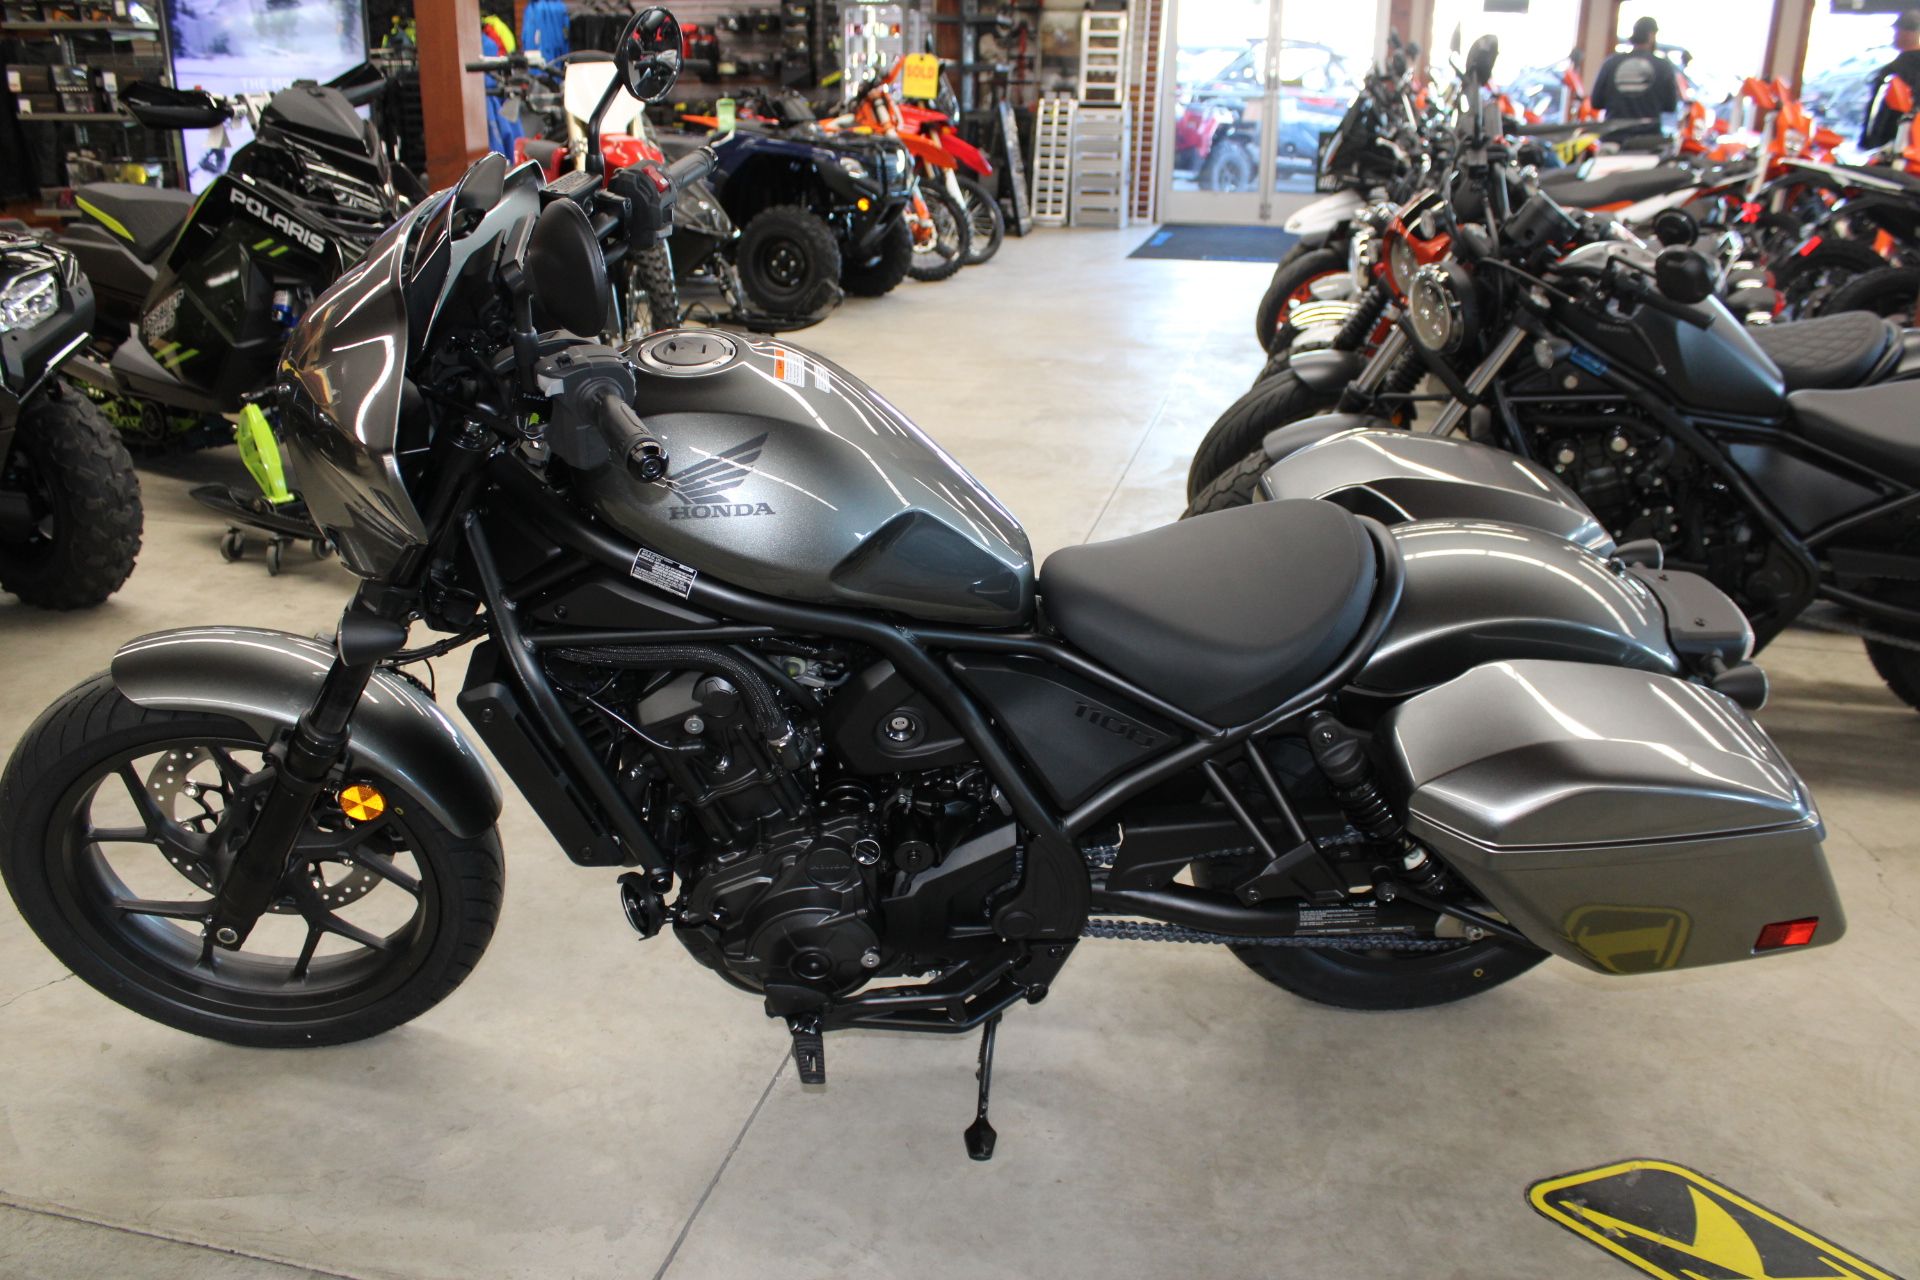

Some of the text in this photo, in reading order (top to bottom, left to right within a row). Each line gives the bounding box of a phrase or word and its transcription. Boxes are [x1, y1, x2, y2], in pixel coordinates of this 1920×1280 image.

[906, 64, 936, 80] SOLD
[230, 188, 326, 254] POLARIS
[669, 502, 776, 521] HONDA
[1074, 700, 1155, 748] 1100
